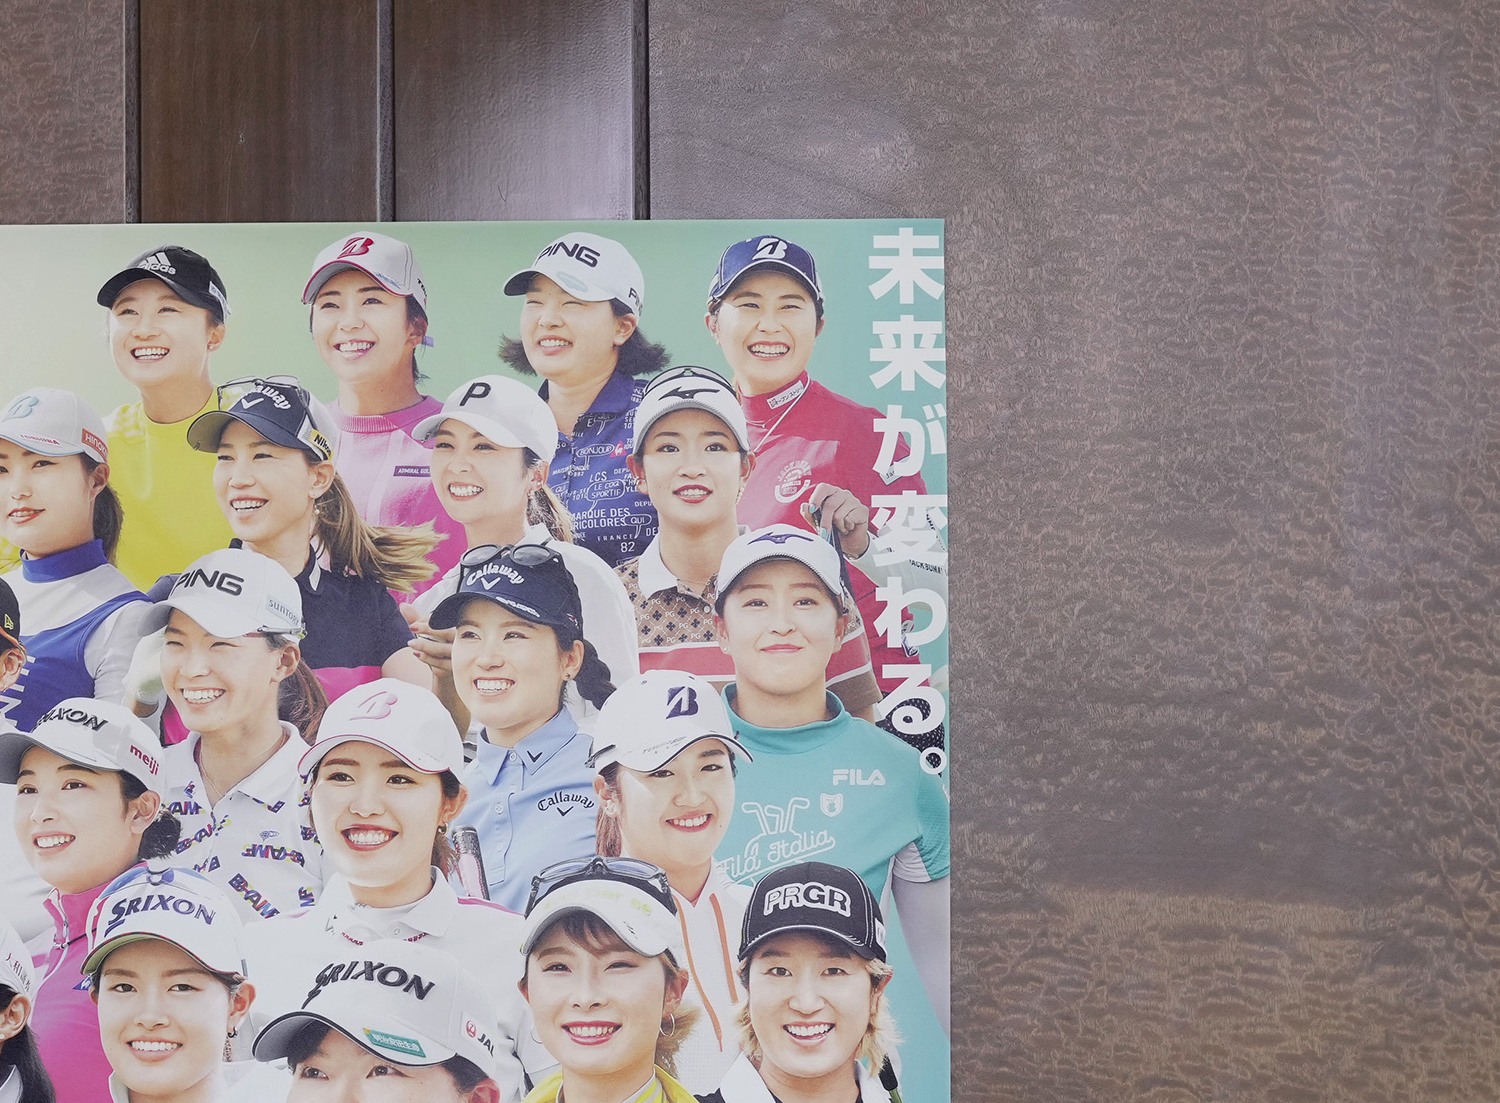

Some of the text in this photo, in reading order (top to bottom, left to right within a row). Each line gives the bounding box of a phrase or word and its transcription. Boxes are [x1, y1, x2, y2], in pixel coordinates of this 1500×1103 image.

[534, 241, 601, 268] PING
[589, 471, 607, 483] LCS
[591, 488, 621, 499] SPORTIF
[867, 226, 949, 776] 未来が変わる。
[610, 507, 631, 518] DES
[630, 516, 645, 525] QUI
[597, 534, 634, 542] FRANCE
[620, 541, 635, 553] 82
[170, 568, 245, 597] PING
[466, 562, 525, 586] Callaway
[268, 599, 300, 626] SUNTORY
[130, 744, 160, 776] meiji
[832, 769, 886, 786] FILA
[537, 791, 595, 812] Callaway
[767, 829, 833, 863] Italia
[763, 881, 851, 918] PRGR
[104, 894, 216, 938] SRIXON
[301, 960, 435, 1010] SRIXON
